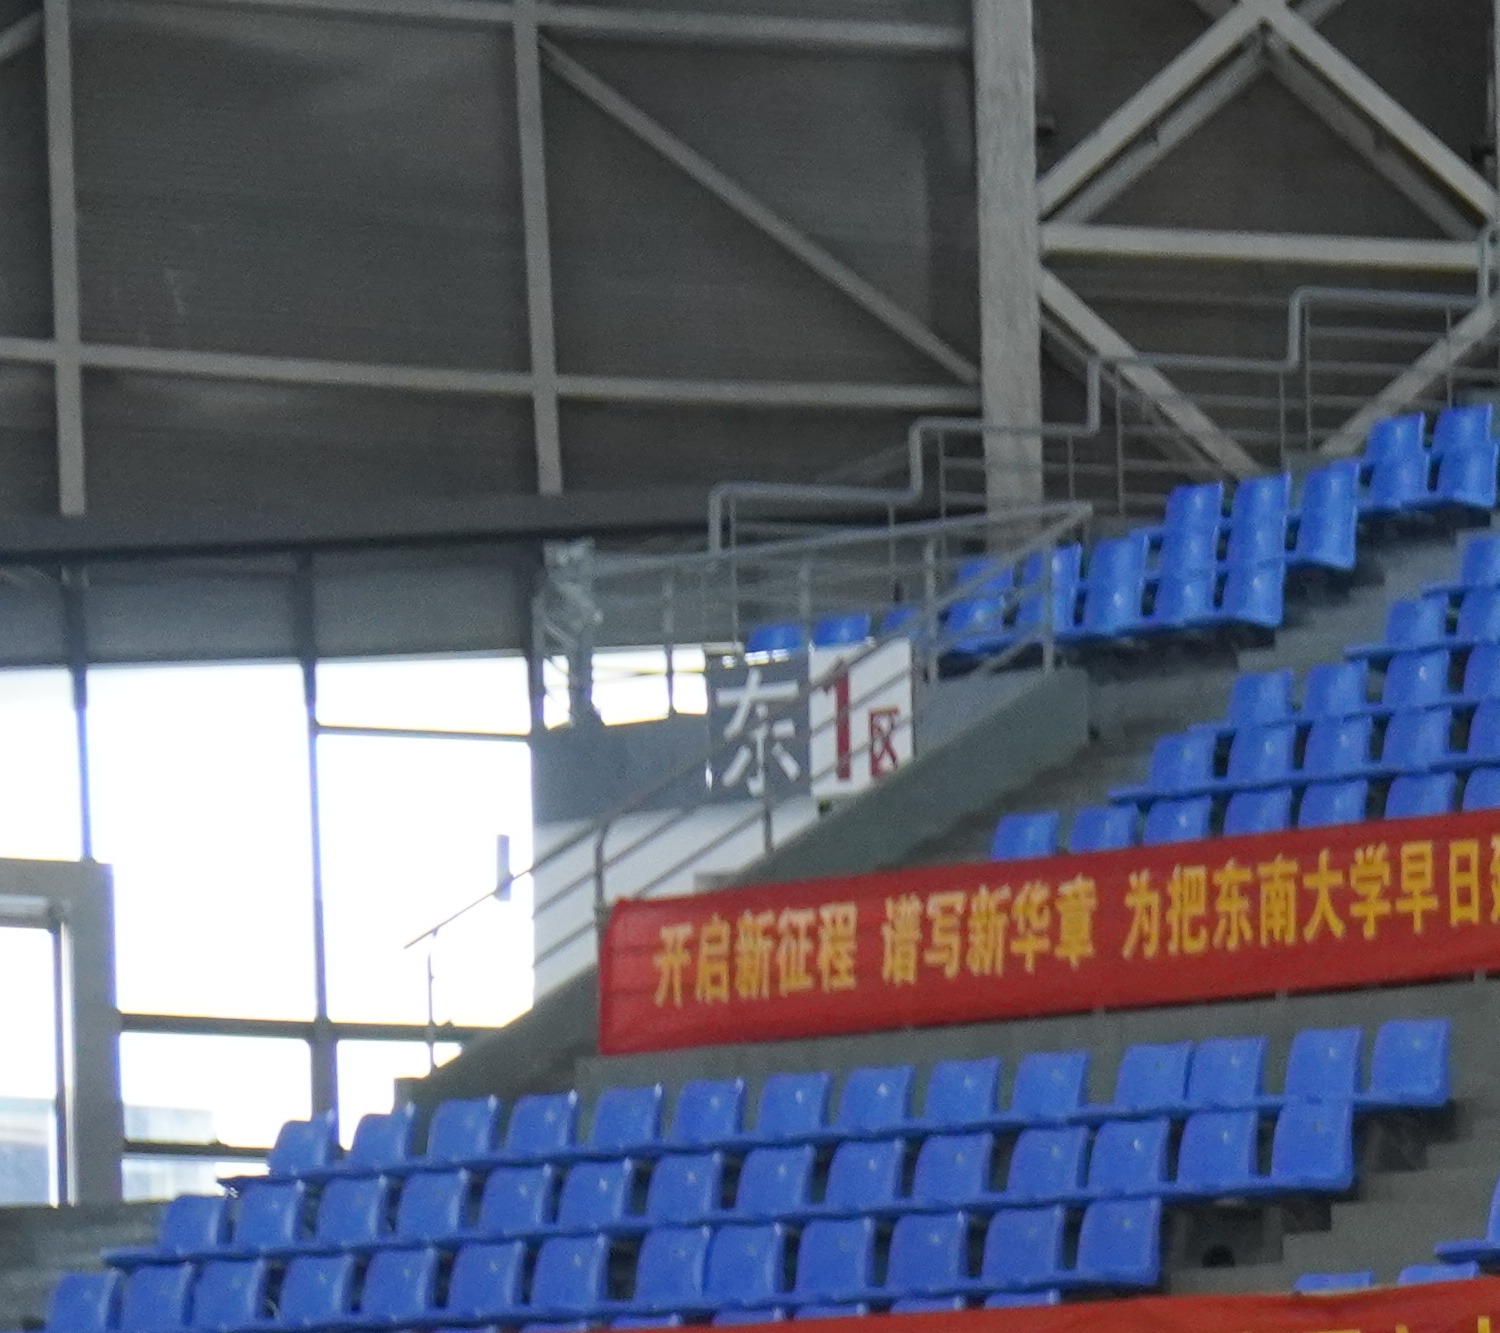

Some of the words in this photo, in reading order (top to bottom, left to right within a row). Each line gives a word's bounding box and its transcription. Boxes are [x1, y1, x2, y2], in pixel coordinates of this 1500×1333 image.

[654, 901, 858, 1007] 开启新征程
[880, 873, 1098, 986] 谱写新华章
